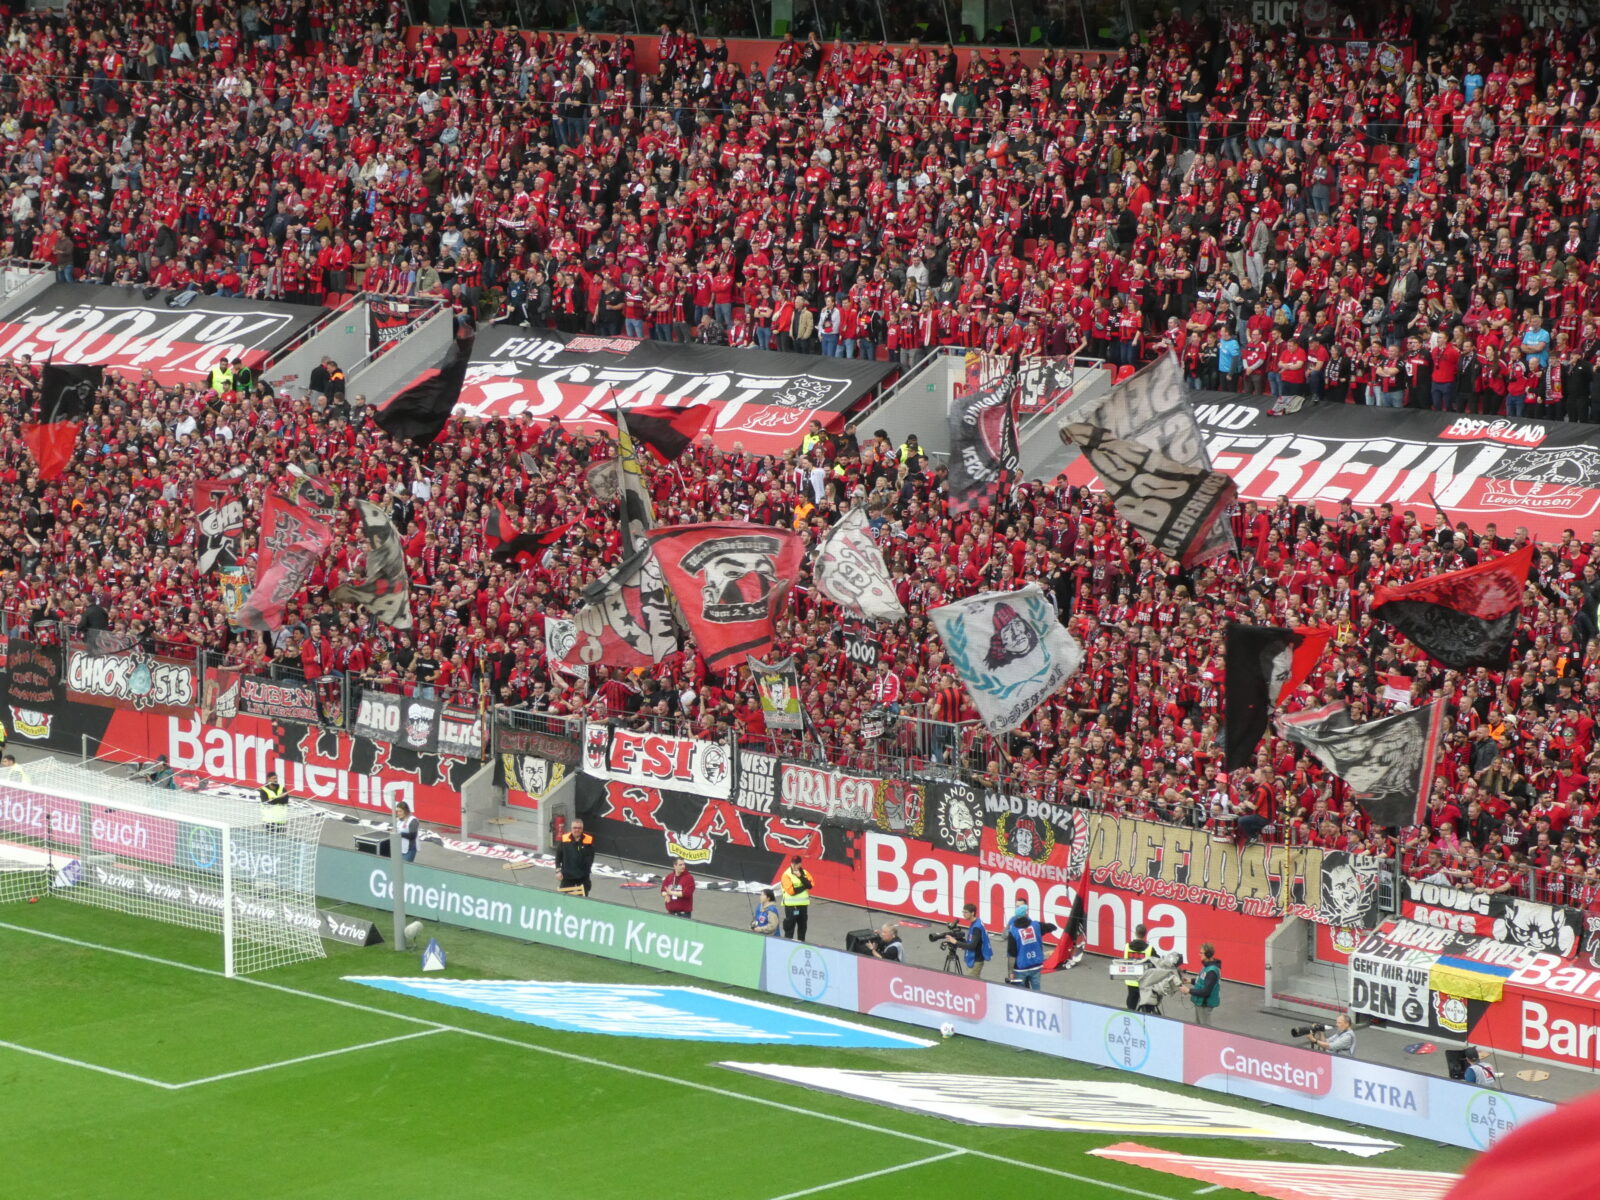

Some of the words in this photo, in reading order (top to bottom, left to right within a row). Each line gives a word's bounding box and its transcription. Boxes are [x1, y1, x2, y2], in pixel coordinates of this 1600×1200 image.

[490, 337, 564, 363] FÜR
[508, 361, 789, 433] STADT
[1504, 423, 1546, 443] LAND
[1486, 495, 1572, 507] Leverkusen
[357, 700, 400, 732] BRO
[741, 752, 777, 776] WEST
[740, 771, 775, 795] SIDE
[737, 788, 774, 813] BOYZ
[984, 793, 1023, 814] MAD
[1026, 799, 1073, 831] BOYZ
[51, 809, 80, 834] au
[92, 817, 147, 849] euch
[979, 849, 1068, 882] LEVERKUSEN
[107, 874, 135, 889] trive
[152, 882, 181, 899] trive
[1407, 880, 1490, 915] YOUNG
[247, 902, 275, 920] trive
[293, 912, 322, 930] trive
[1413, 905, 1477, 934] BOYS
[338, 922, 366, 940] trive
[520, 904, 614, 947] unterm
[625, 919, 705, 967] Kreuz
[1026, 951, 1037, 960] 03
[791, 965, 826, 982] BAYER
[1353, 957, 1379, 977] GEHT
[1381, 963, 1403, 983] MIR
[1405, 969, 1428, 987] AUF
[1507, 952, 1600, 998] Bar
[1352, 977, 1397, 1017] DEN
[1005, 1003, 1061, 1034] EXTRA
[1522, 1000, 1600, 1061] Bar
[1107, 1034, 1147, 1050] BAYER
[1353, 1078, 1417, 1112] EXTRA
[1470, 1112, 1514, 1132] BAYER
